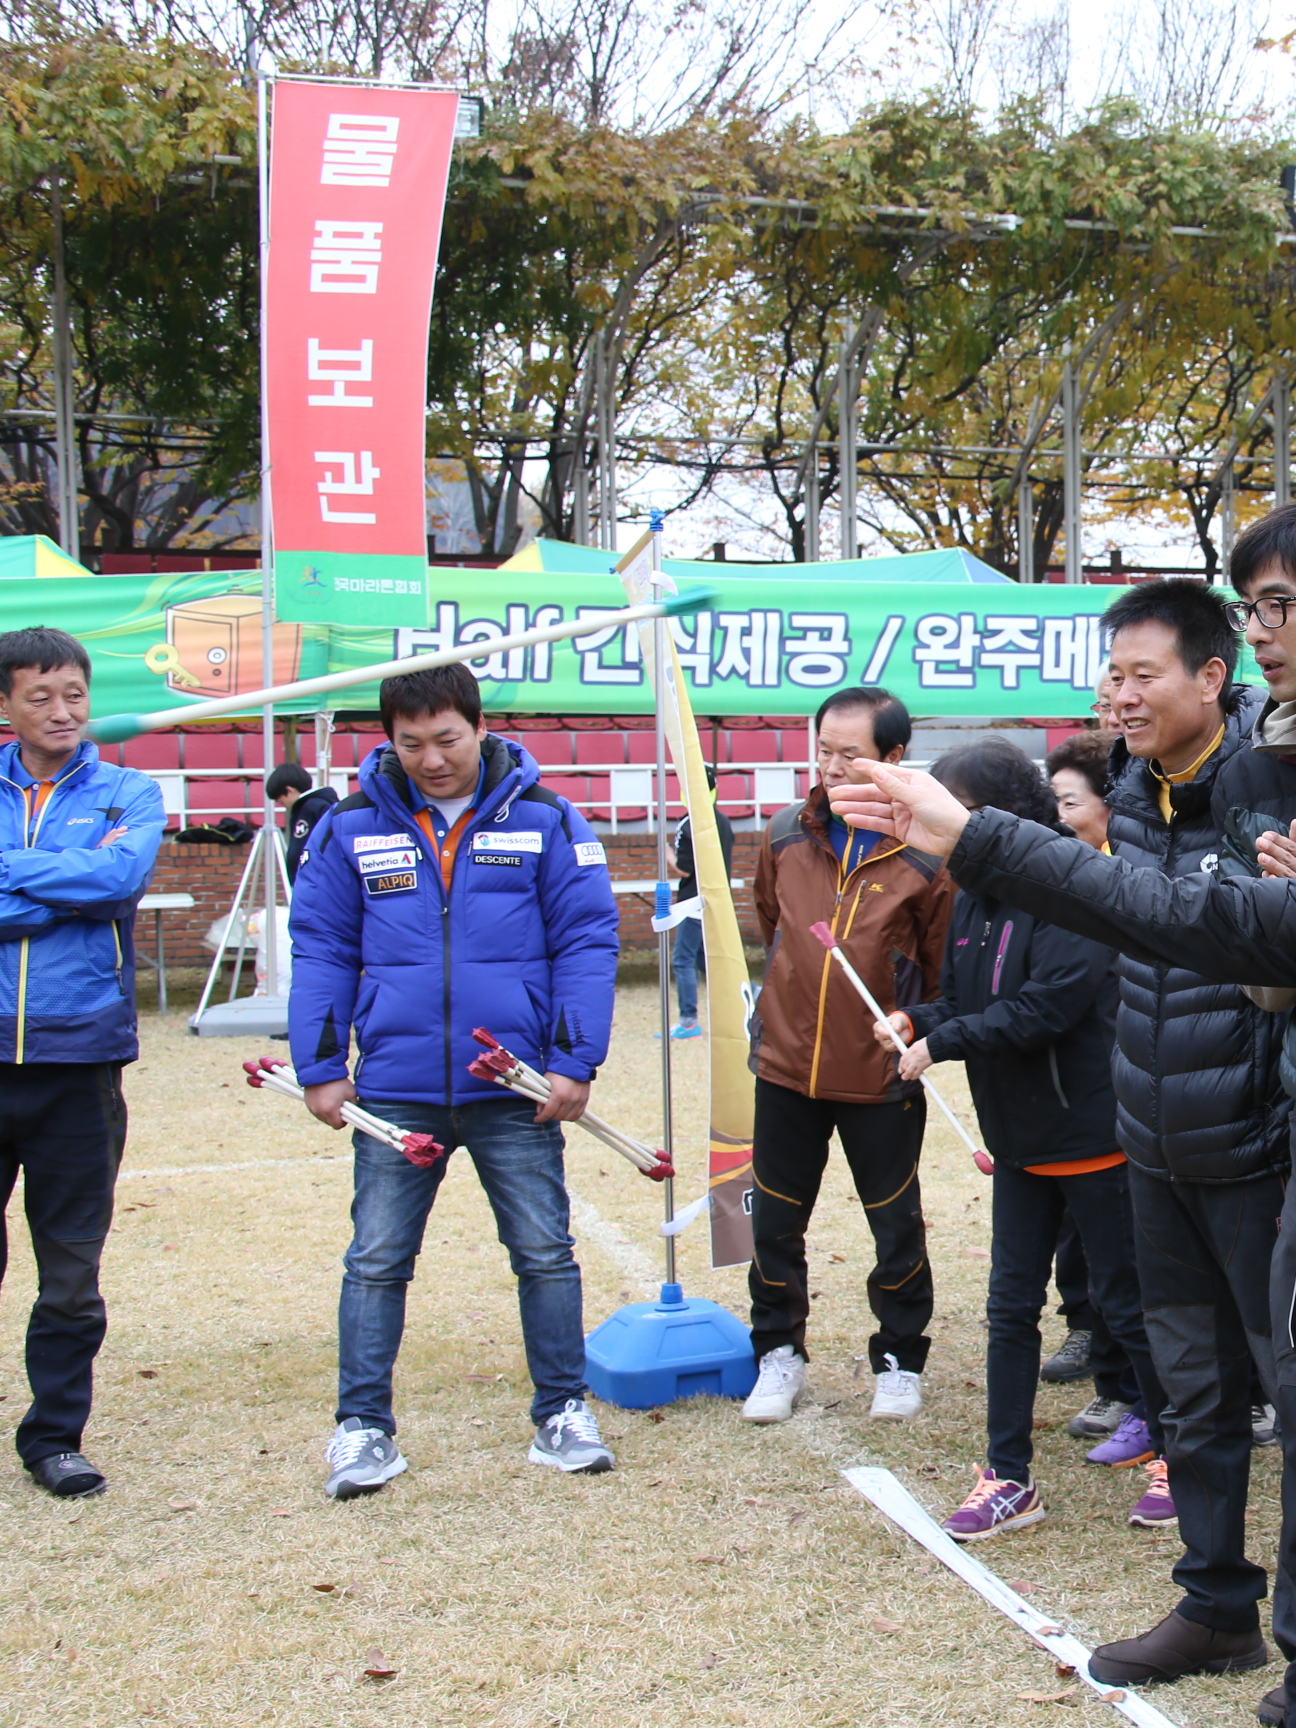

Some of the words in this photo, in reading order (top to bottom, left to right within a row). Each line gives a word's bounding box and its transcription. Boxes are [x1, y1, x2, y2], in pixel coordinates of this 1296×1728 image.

[395, 601, 563, 683] Half
[573, 606, 851, 688] 간식제공
[914, 612, 1109, 691] 완주메
[356, 836, 414, 850] RAIFFEISEN
[493, 836, 540, 845] swisscom
[361, 857, 399, 870] helvetia
[474, 855, 521, 866] DESCENTE
[377, 874, 414, 891] ALPIQ
